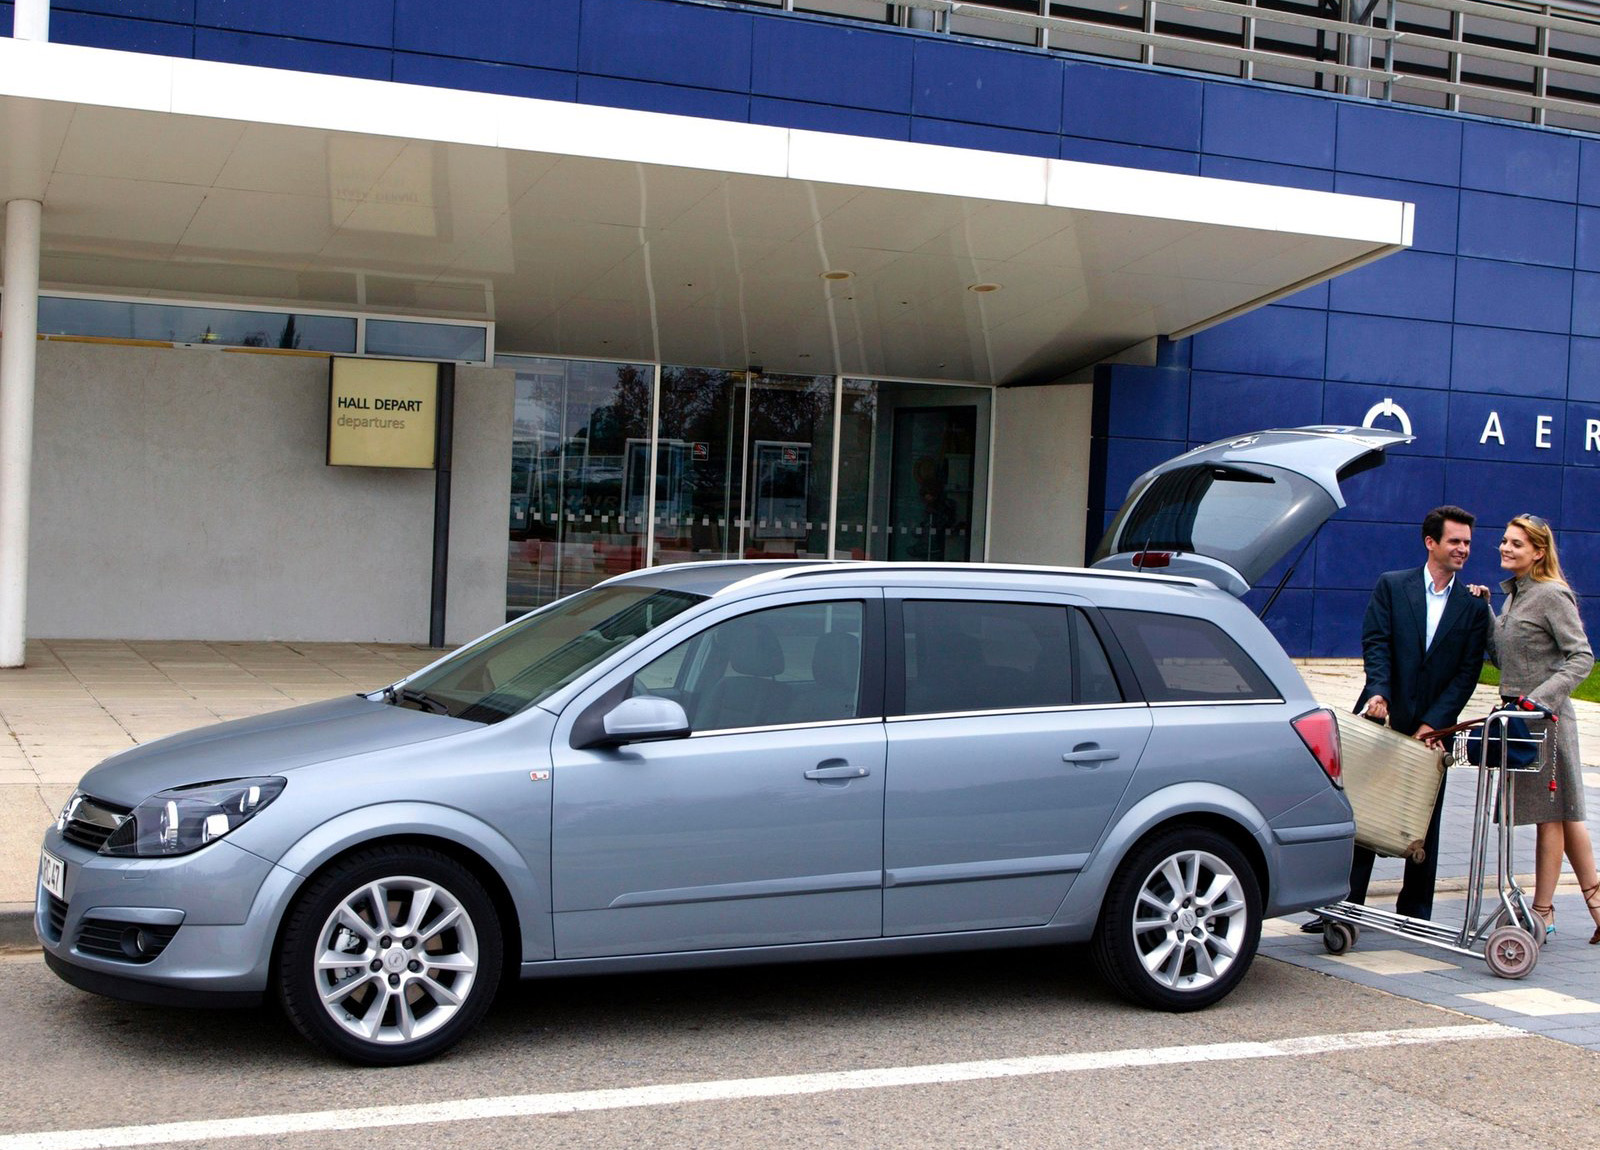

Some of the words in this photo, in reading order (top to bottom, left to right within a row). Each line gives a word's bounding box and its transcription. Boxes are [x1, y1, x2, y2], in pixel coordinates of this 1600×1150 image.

[338, 397, 370, 410] HALL
[375, 399, 423, 412] DEPART
[337, 414, 405, 430] departures
[1479, 411, 1600, 452] AER
